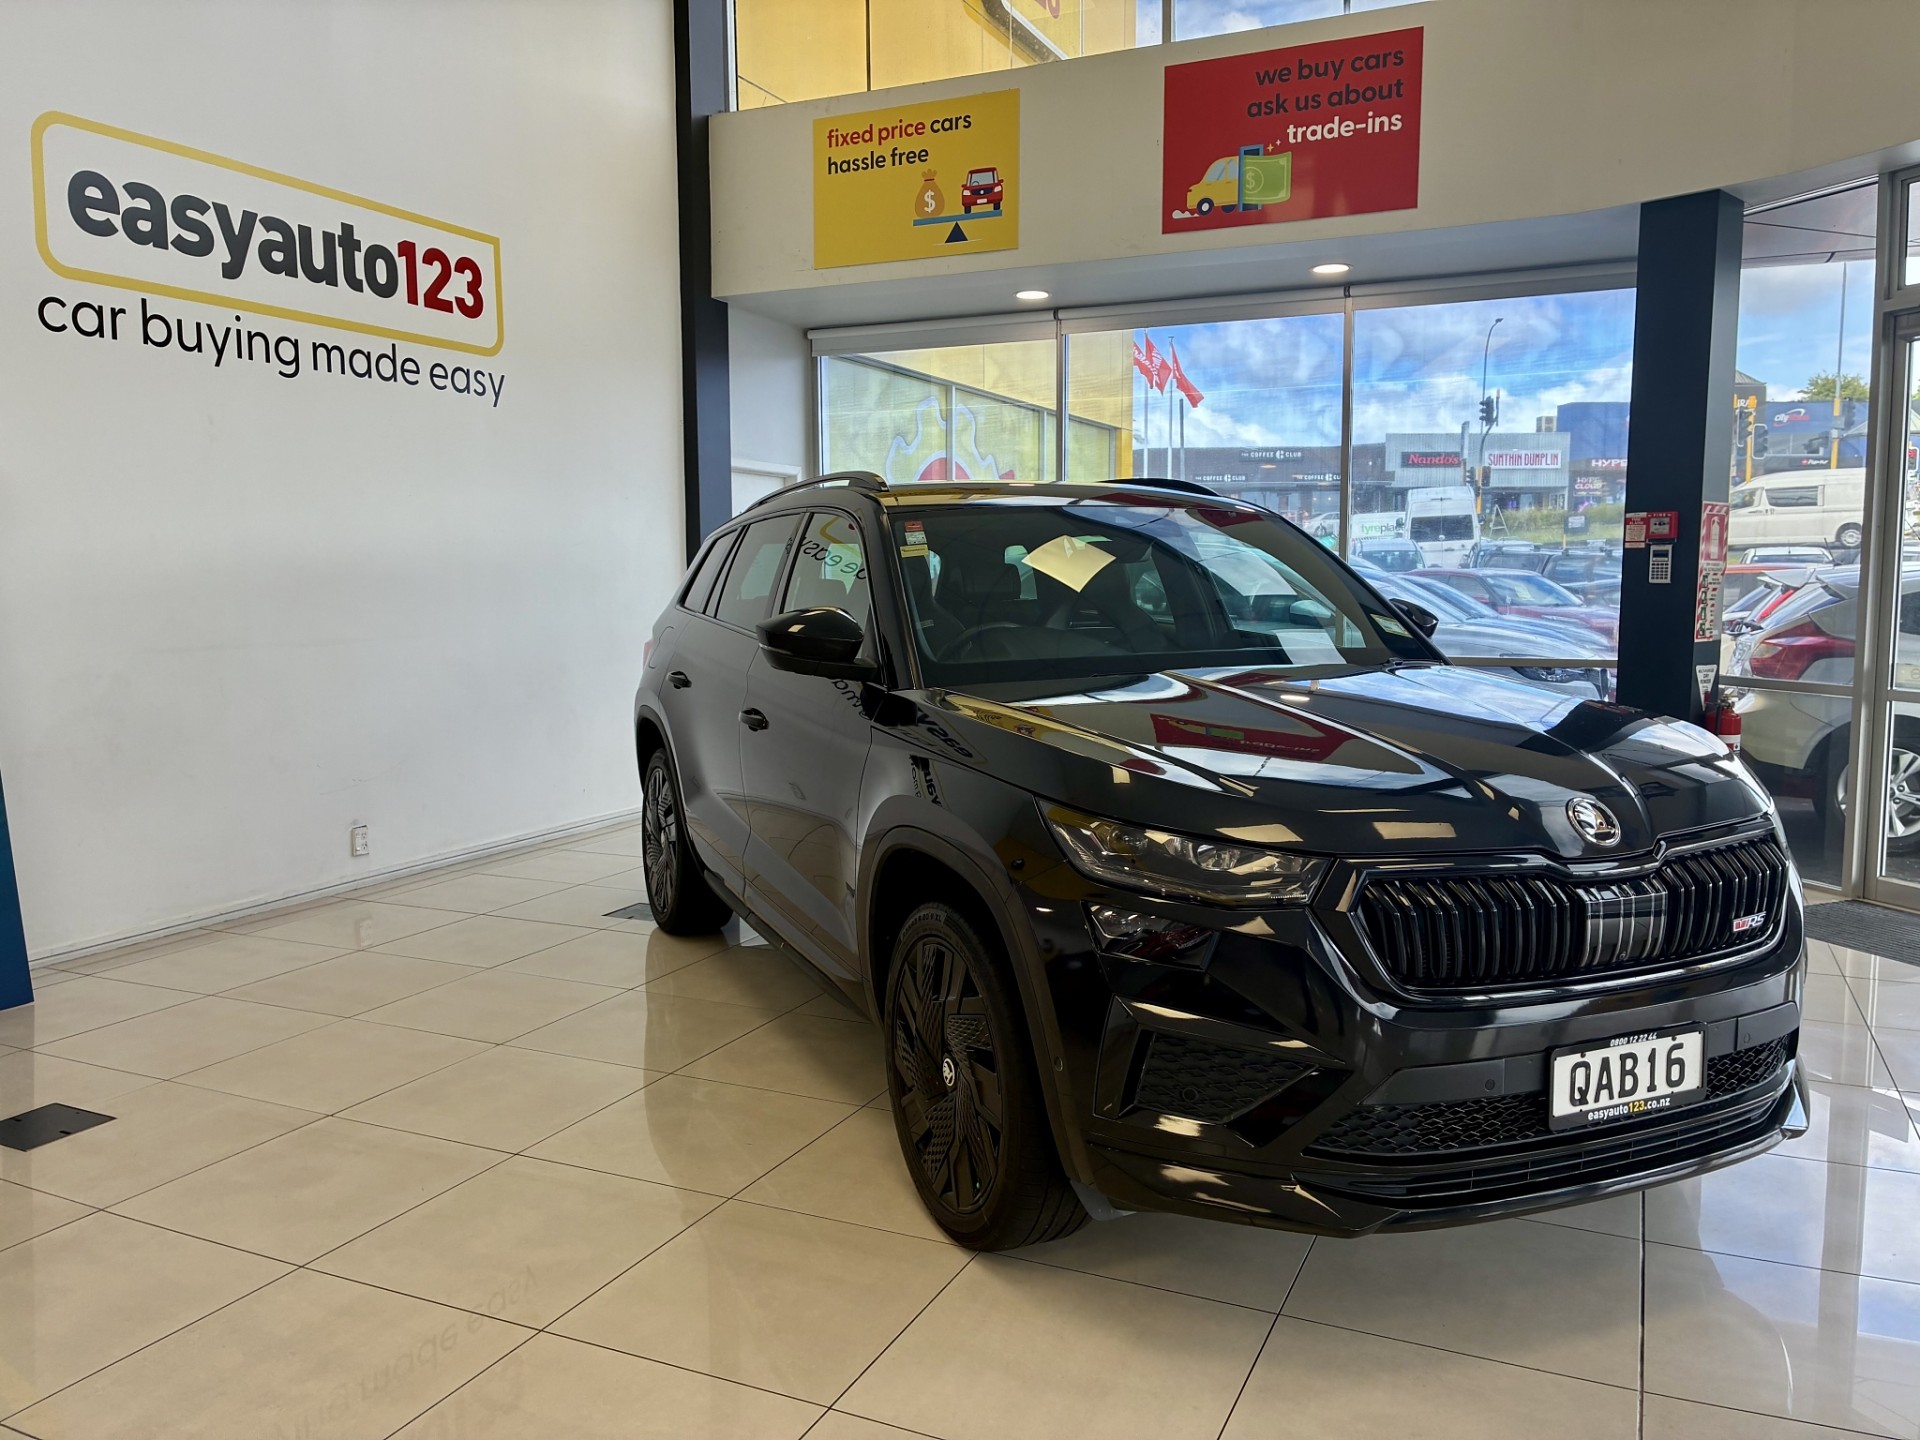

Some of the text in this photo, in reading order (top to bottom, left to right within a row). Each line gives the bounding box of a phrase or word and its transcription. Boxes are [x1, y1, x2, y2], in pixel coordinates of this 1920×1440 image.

[1255, 49, 1405, 86] we buy cars
[1246, 78, 1404, 118] ask us about
[827, 114, 972, 148] fixed price cars
[1286, 111, 1403, 144] trade-ins
[827, 146, 929, 175] hassle free
[67, 169, 484, 319] easyauto123
[37, 296, 506, 408] car buying made easy
[1408, 452, 1459, 465] Nando's
[1524, 453, 1559, 466] DUMPLIN
[1610, 1037, 1628, 1047] 0800
[1629, 1035, 1638, 1044] 12
[1570, 1043, 1685, 1107] QAB16
[1588, 1097, 1671, 1121] easyauto123.co.nz
